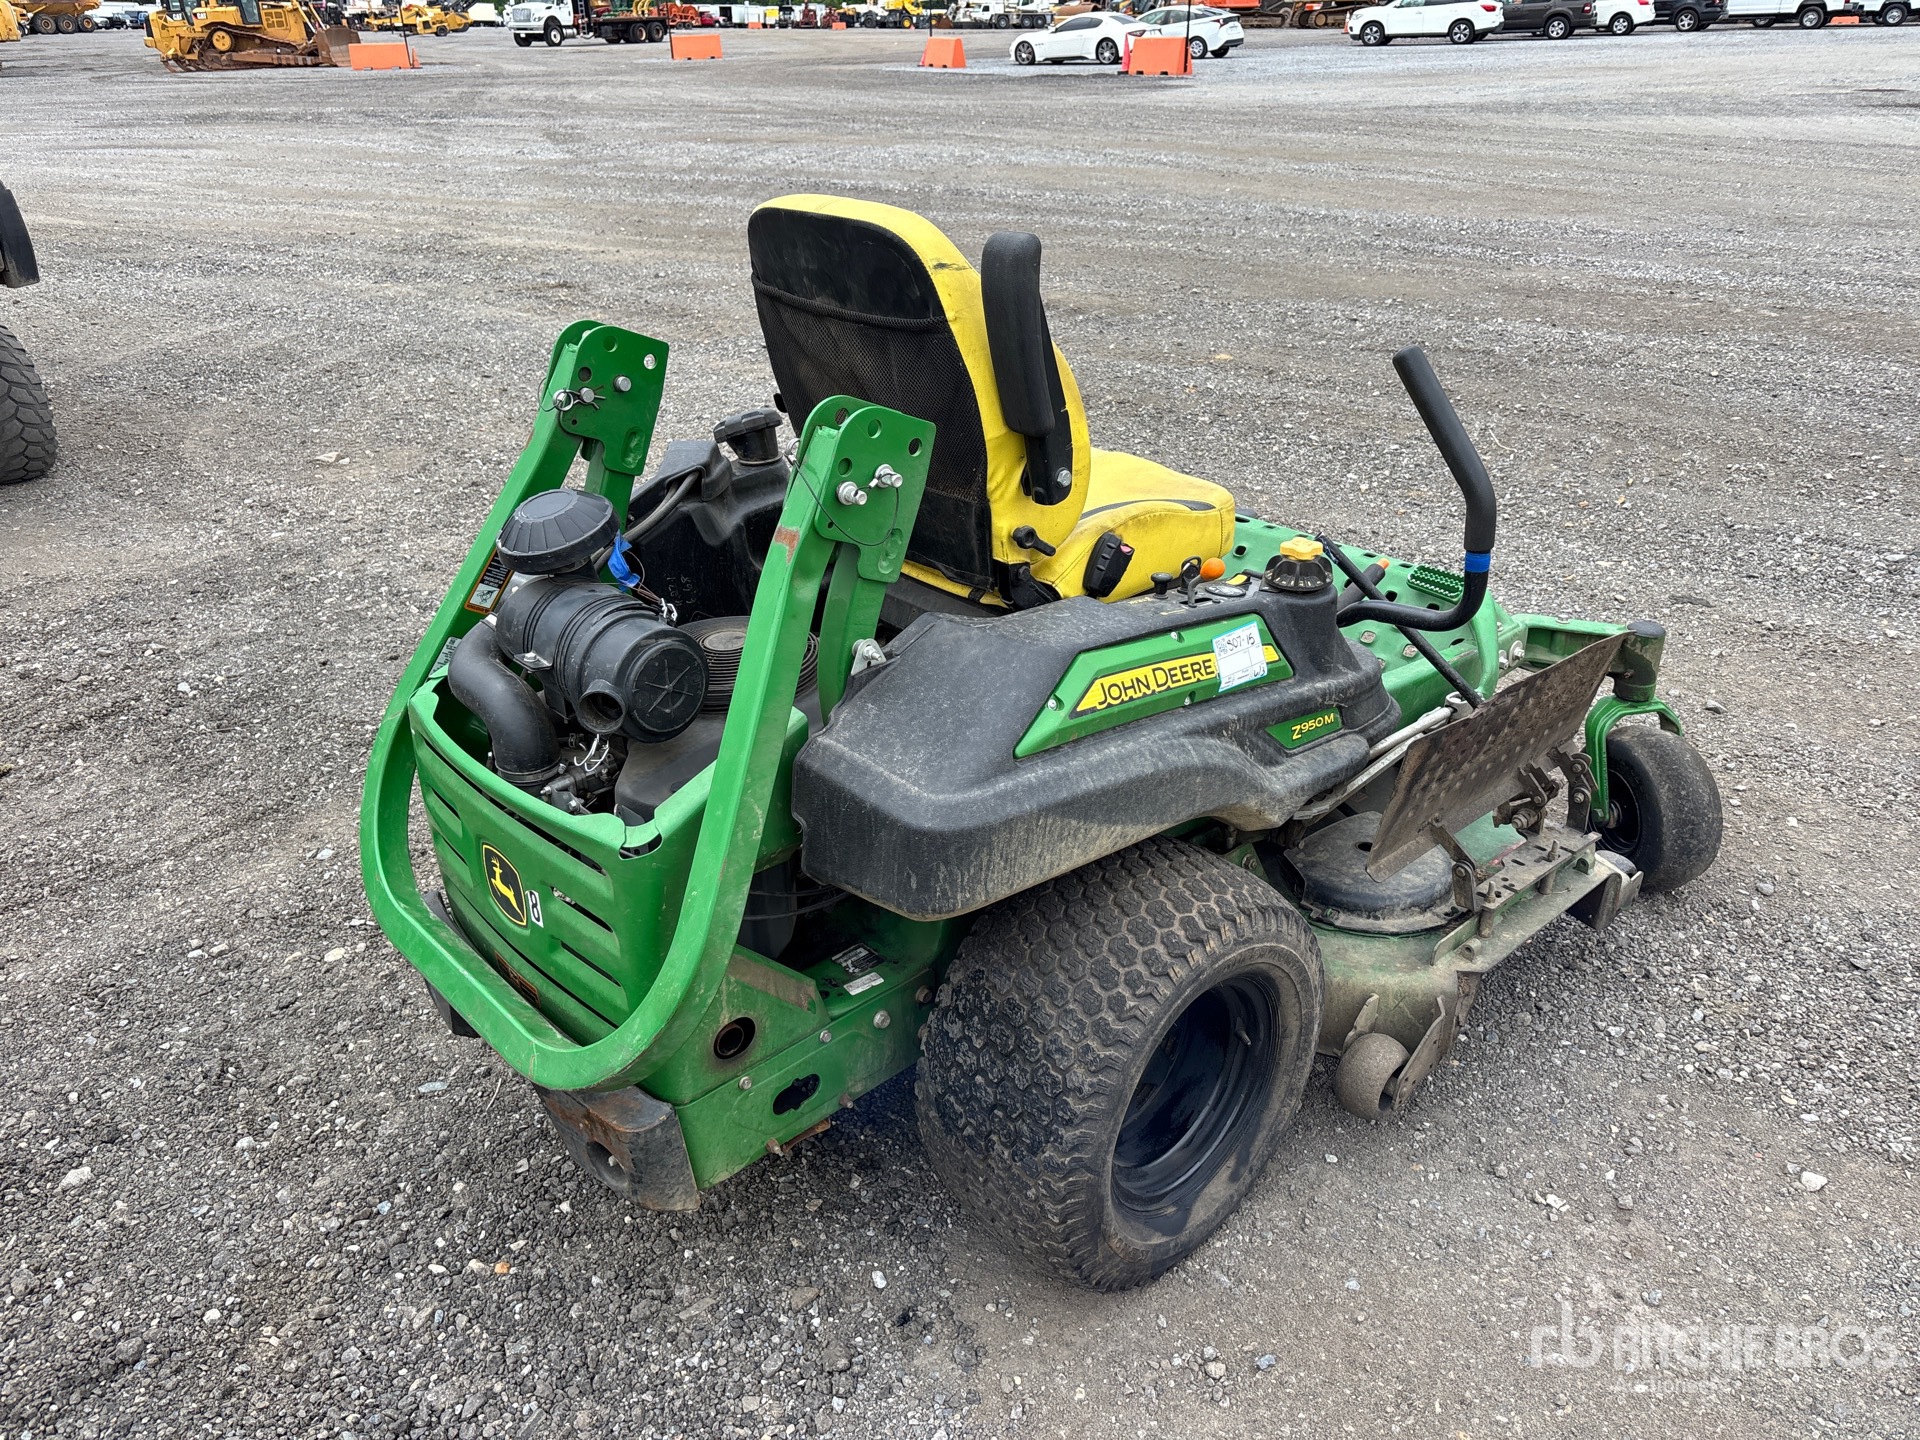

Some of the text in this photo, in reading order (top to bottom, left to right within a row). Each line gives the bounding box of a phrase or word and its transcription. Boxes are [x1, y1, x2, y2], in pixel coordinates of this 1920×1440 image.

[1098, 674, 1151, 706] JOHN
[1152, 658, 1215, 689] DEERE
[1291, 712, 1335, 740] Z950M
